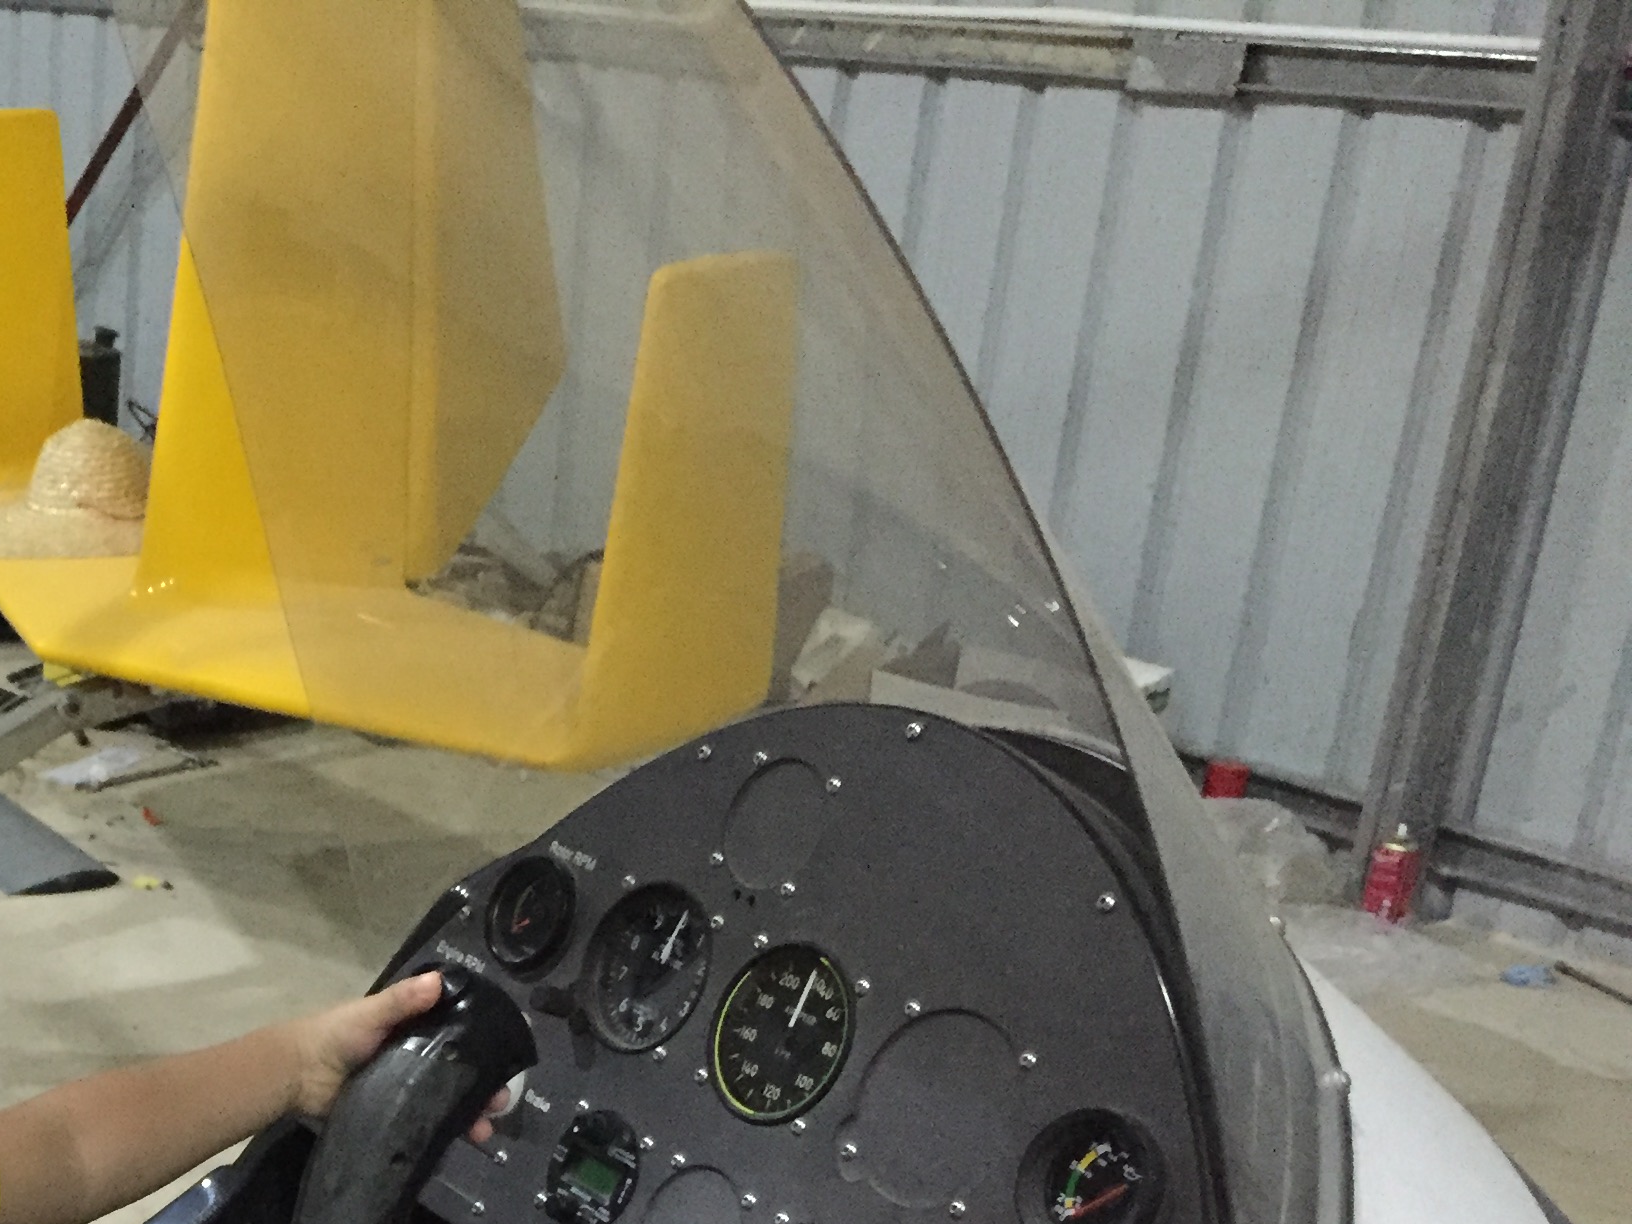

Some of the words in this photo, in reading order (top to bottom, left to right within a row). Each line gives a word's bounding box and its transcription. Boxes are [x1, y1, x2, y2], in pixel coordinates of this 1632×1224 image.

[778, 972, 801, 990] 200
[739, 1024, 758, 1042] 160
[821, 1041, 837, 1058] 80
[794, 1073, 814, 1091] 100
[762, 1083, 781, 1101] 120
